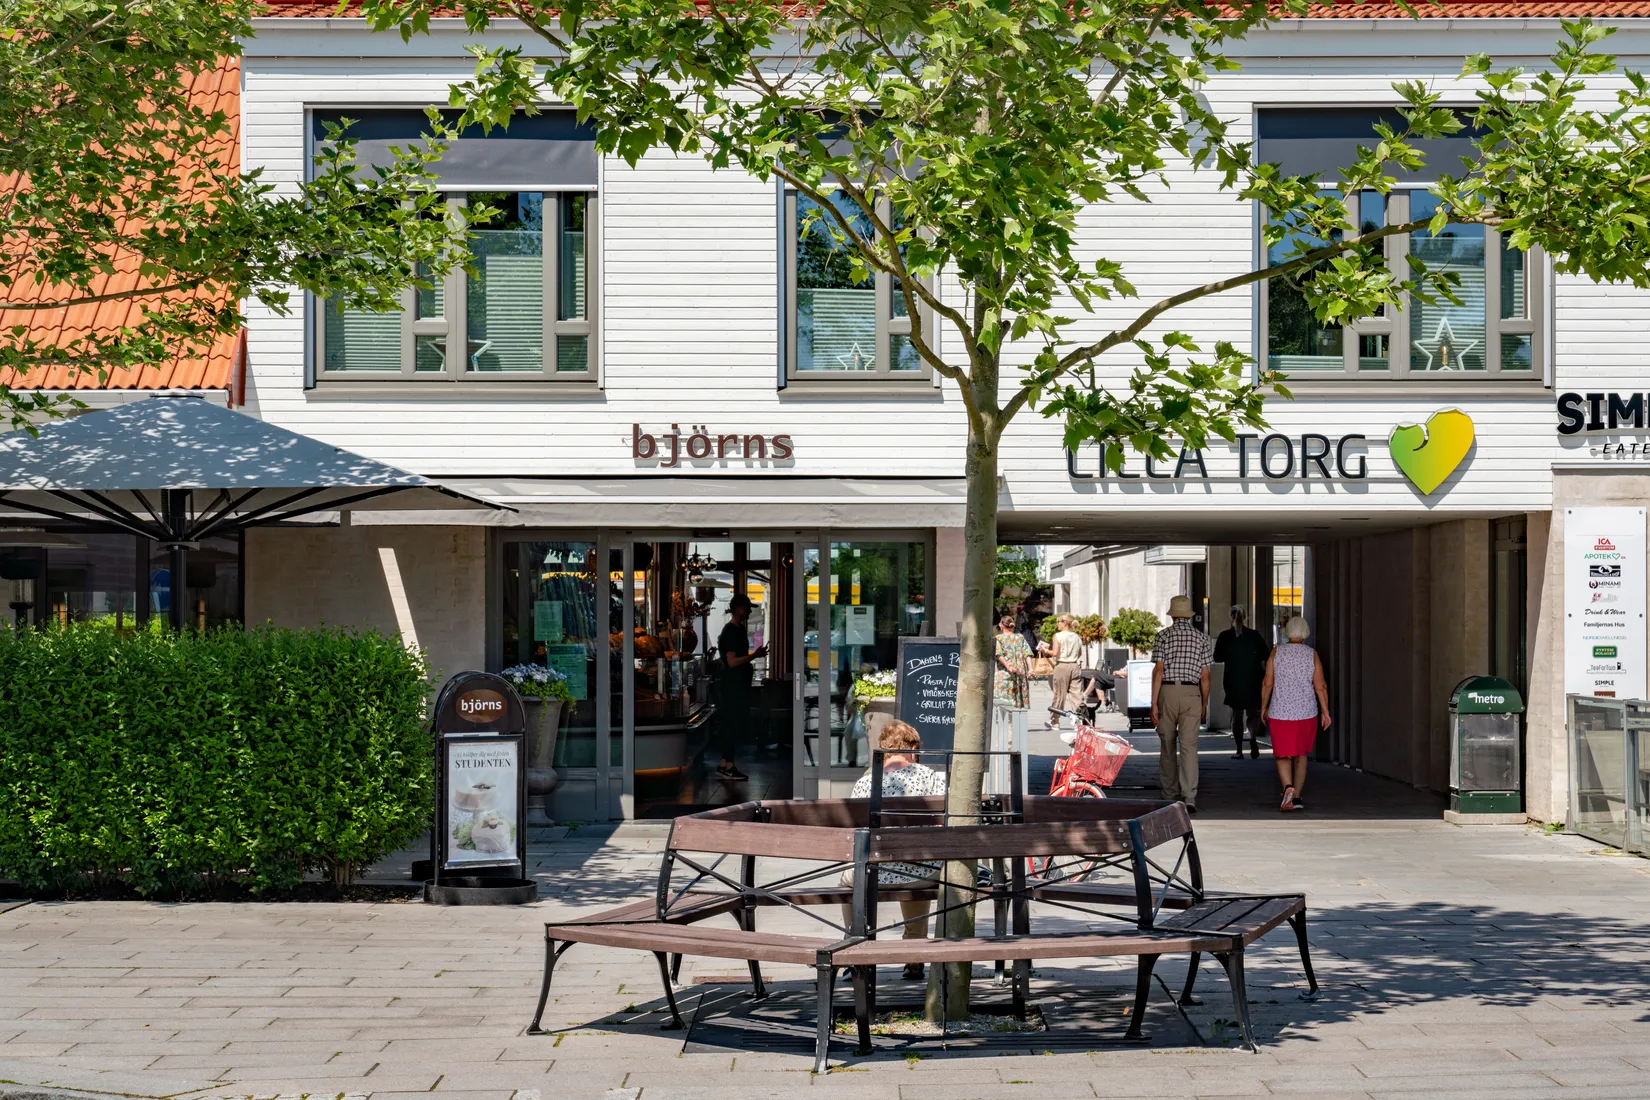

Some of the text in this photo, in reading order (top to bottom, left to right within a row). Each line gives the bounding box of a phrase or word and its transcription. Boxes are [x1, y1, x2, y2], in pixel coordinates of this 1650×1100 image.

[1557, 392, 1650, 434] SIM
[632, 423, 793, 467] björns
[1232, 433, 1366, 479] TORG
[906, 654, 943, 669] DAGENS
[919, 674, 958, 688] PASTA/PE
[1475, 693, 1505, 704] metro
[461, 699, 502, 713] björns
[455, 758, 512, 769] STUDENTEN
